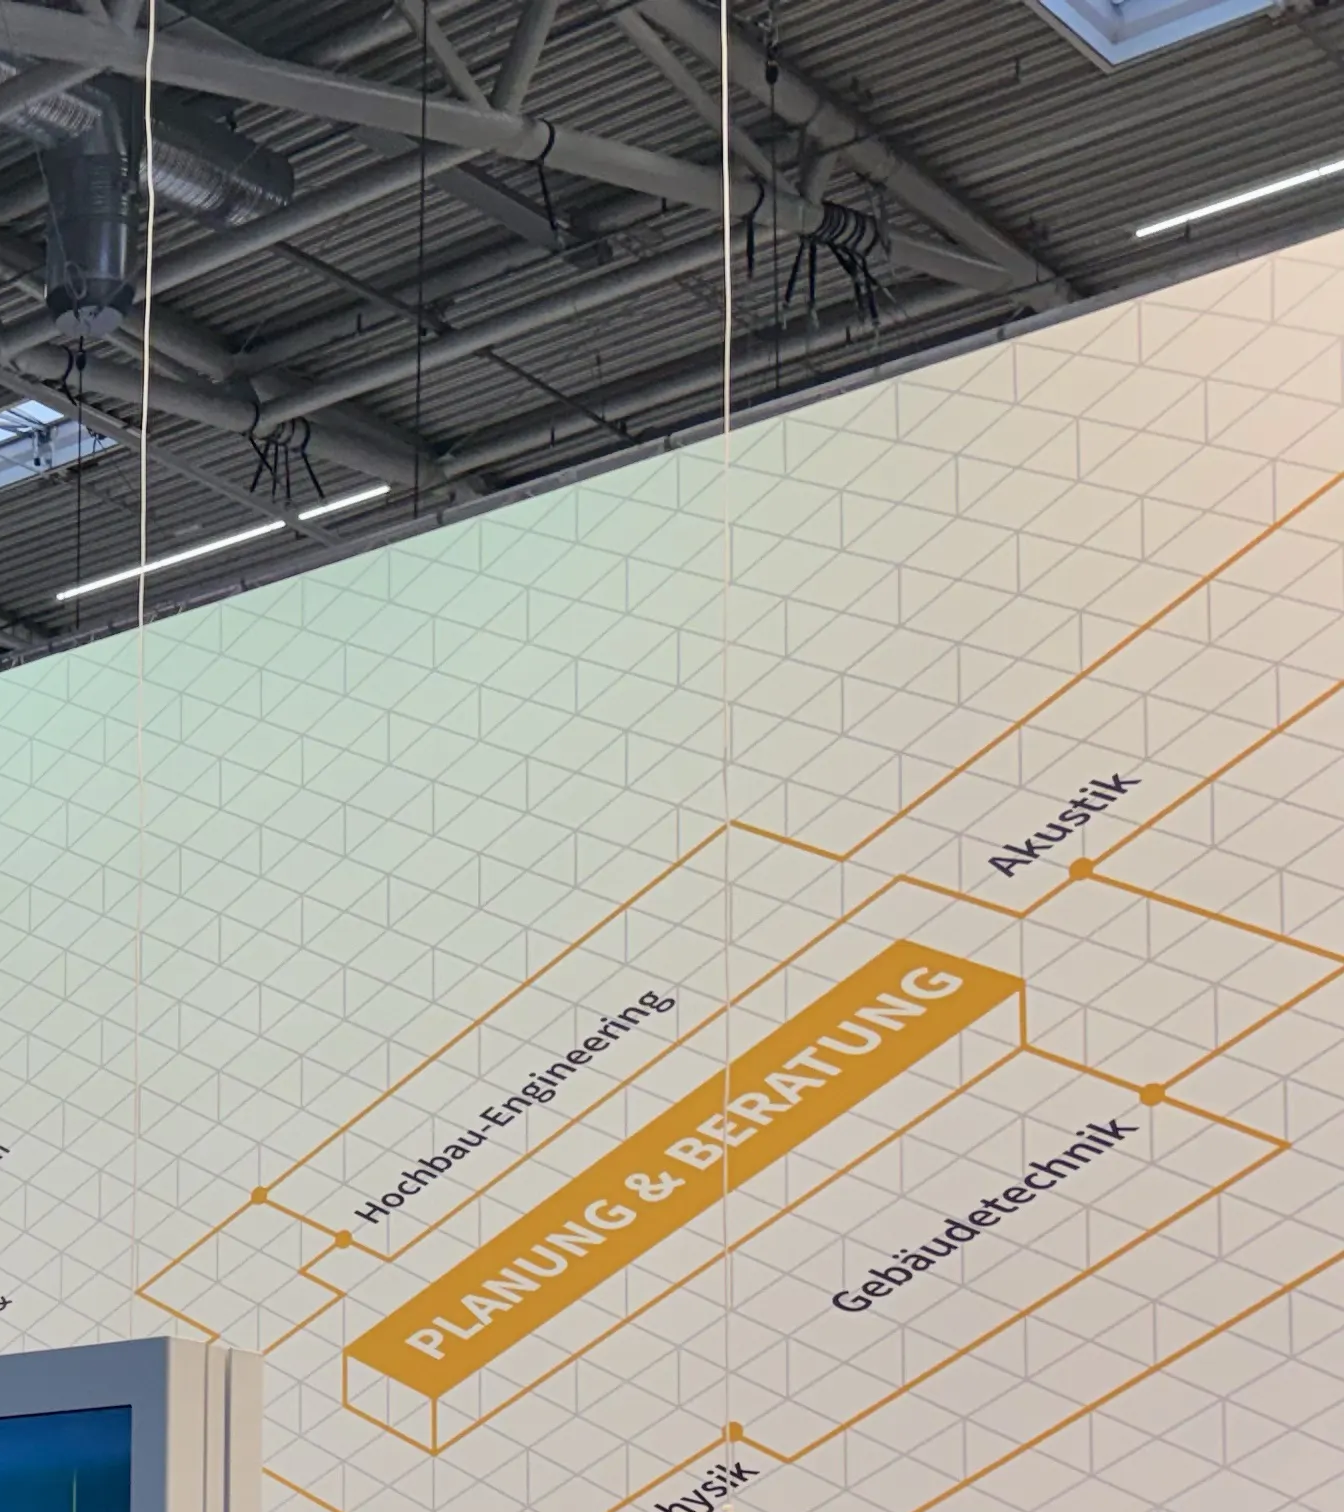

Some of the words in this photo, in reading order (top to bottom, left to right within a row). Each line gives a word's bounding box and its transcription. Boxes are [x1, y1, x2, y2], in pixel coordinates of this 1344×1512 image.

[988, 773, 1141, 877] Akustik
[354, 990, 676, 1225] Hochbau-Engineering
[405, 1199, 637, 1360] PLANUNG
[623, 1172, 685, 1204] &
[664, 965, 964, 1172] BERATUNG
[831, 1119, 1139, 1313] Gebäudetechnik
